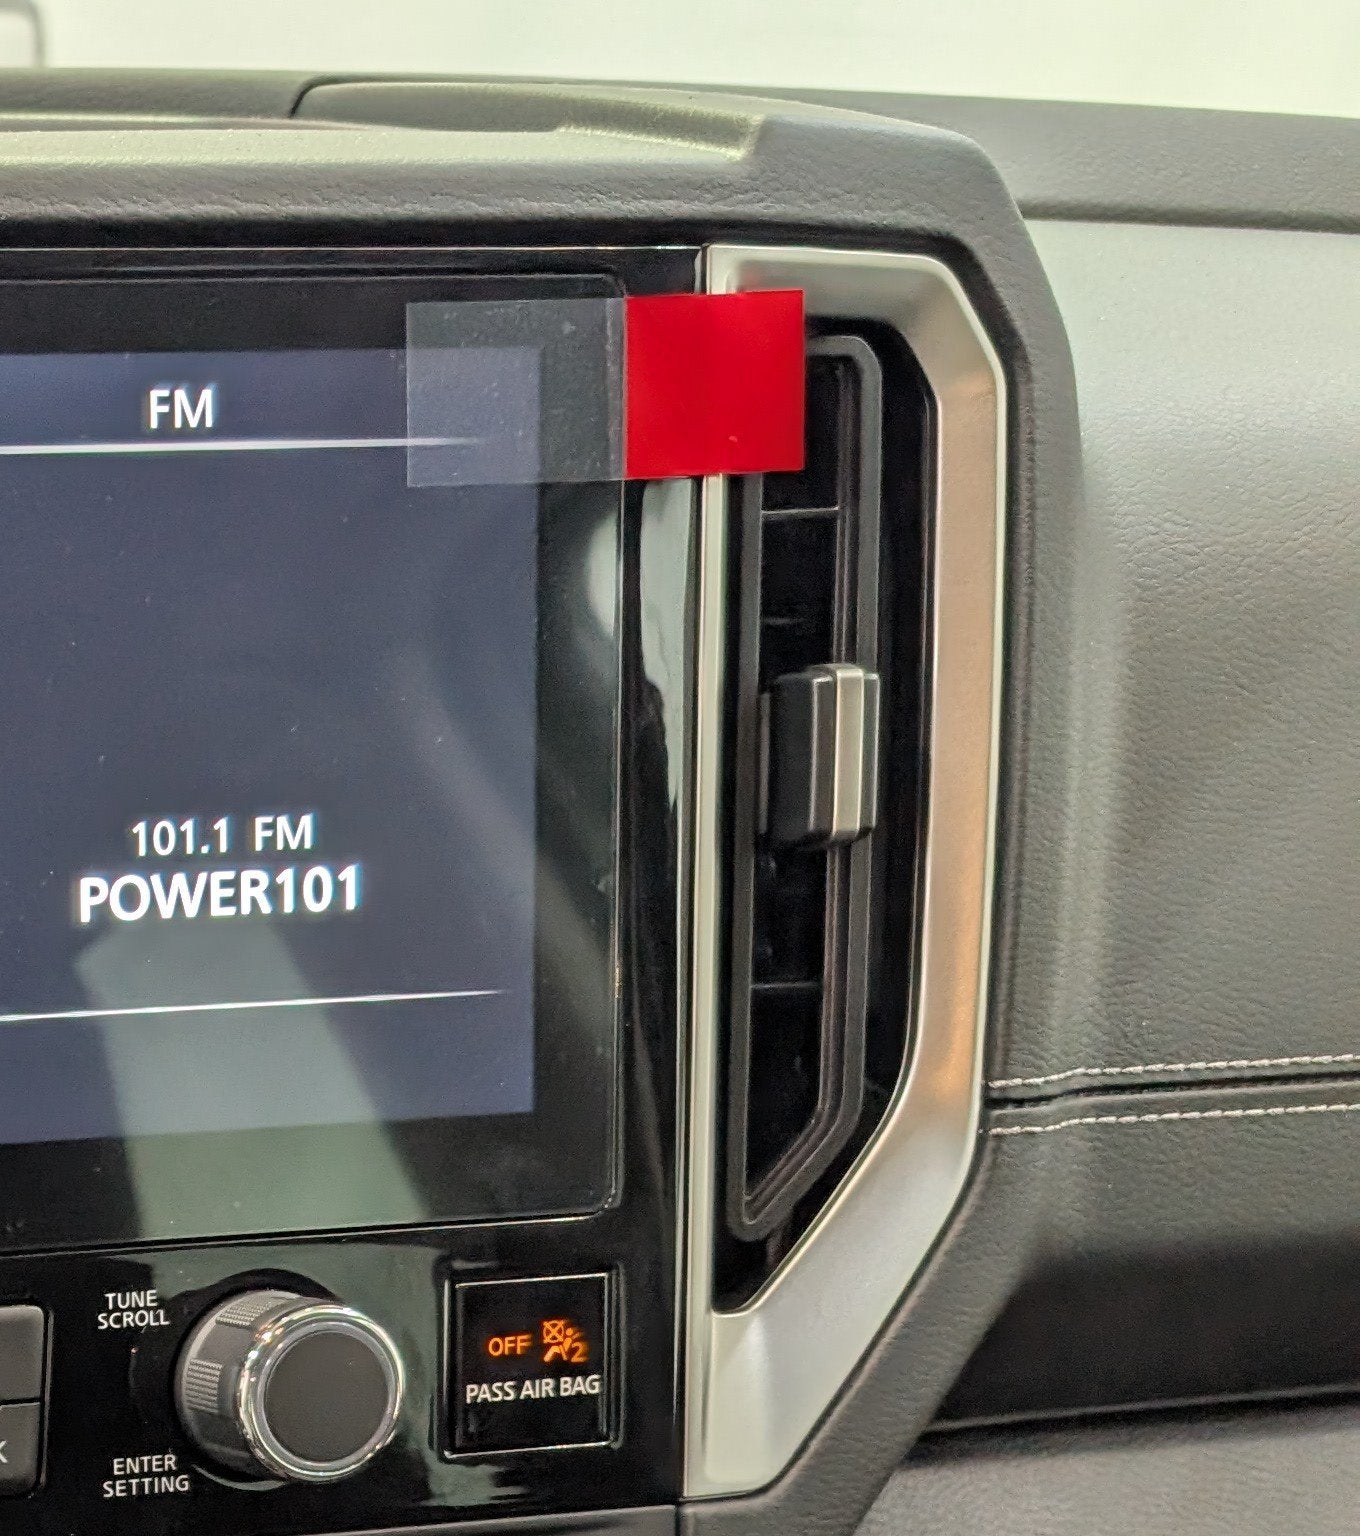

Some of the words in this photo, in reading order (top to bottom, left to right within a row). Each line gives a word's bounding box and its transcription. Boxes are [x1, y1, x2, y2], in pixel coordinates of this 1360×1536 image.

[147, 385, 216, 430] FM
[131, 820, 229, 857] 101.1
[254, 815, 313, 851] FM
[79, 865, 362, 923] POWER101
[105, 1290, 157, 1308] TUNE
[98, 1309, 169, 1330] SCROLL
[489, 1335, 531, 1357] OFF
[466, 1381, 514, 1404] PASS
[520, 1379, 555, 1400] AIR
[560, 1375, 601, 1397] BAG
[112, 1455, 176, 1475] ENTER
[103, 1475, 189, 1498] SETTING
